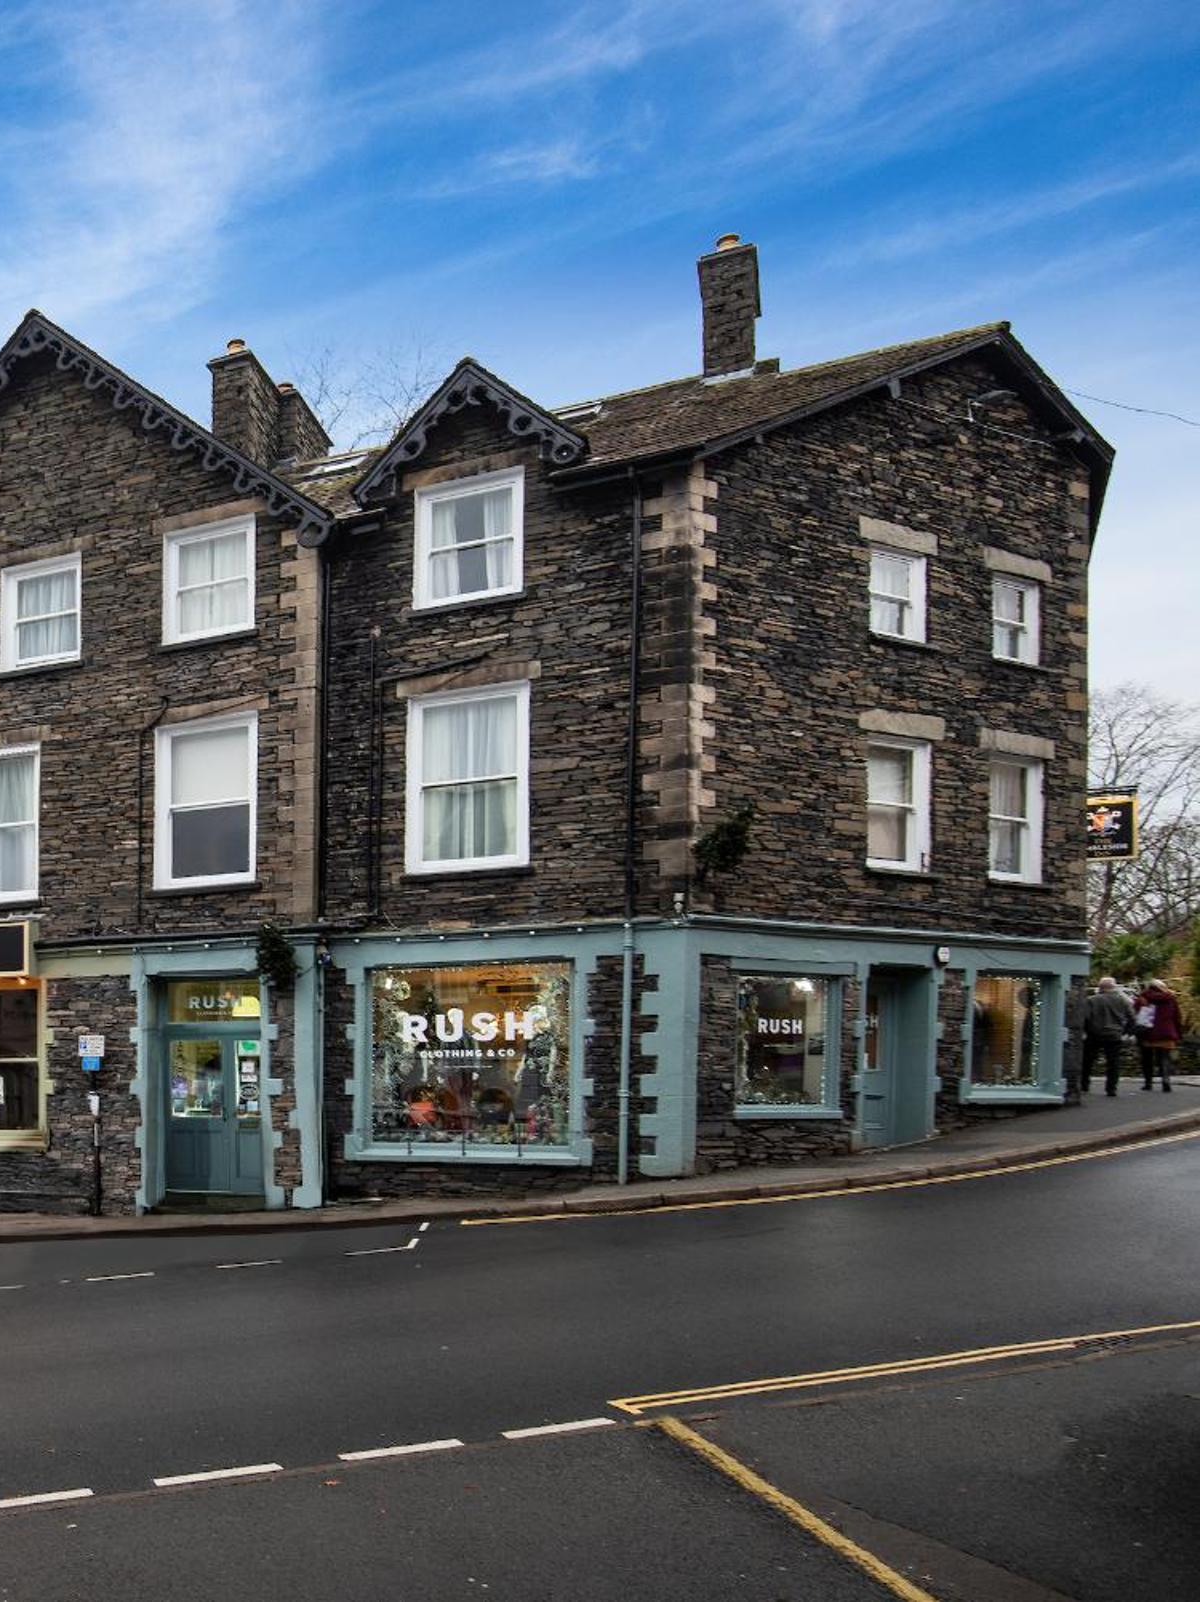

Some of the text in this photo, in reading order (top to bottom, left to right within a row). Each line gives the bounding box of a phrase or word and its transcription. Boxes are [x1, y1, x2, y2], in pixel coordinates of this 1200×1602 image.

[401, 1010, 535, 1043] RUSH
[757, 1018, 803, 1035] RUSH
[419, 1048, 516, 1059] CLOTHING & CO
